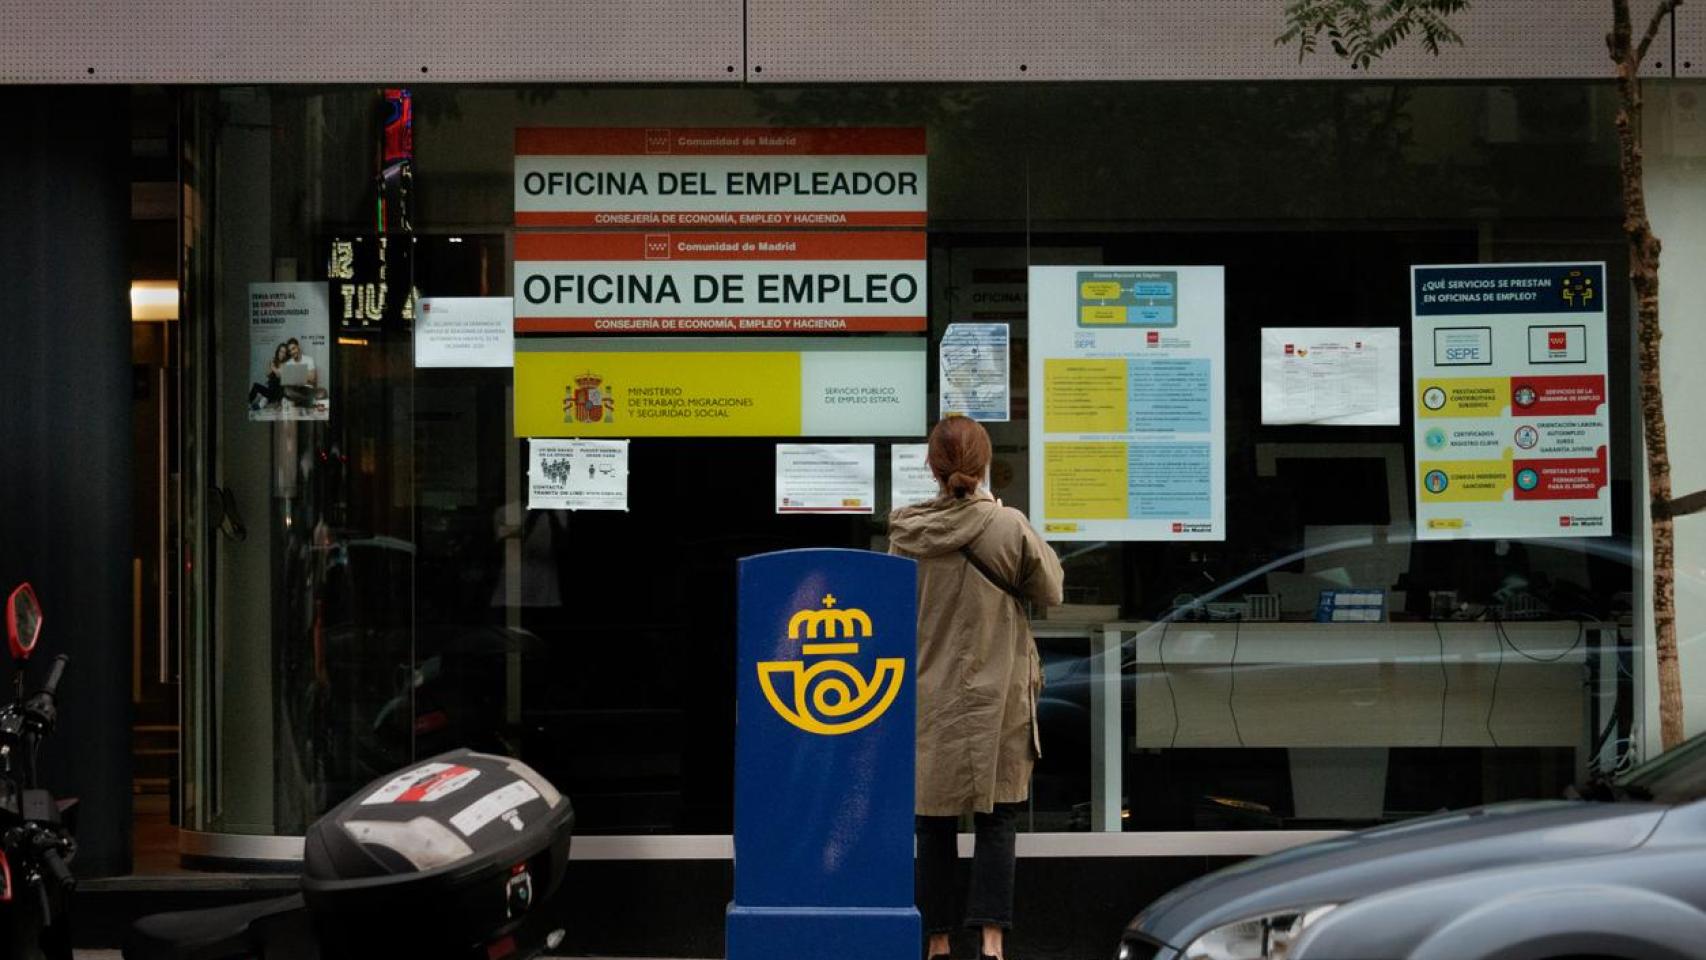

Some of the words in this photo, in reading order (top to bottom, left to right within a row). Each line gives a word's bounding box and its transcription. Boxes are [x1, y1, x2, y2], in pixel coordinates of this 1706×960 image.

[678, 137, 740, 147] Comunidad
[743, 137, 755, 147] de
[758, 137, 797, 147] Madrid
[523, 172, 648, 196] OFICINA
[658, 172, 716, 195] DEL
[727, 172, 918, 196] EMPLEADOR
[594, 212, 660, 225] CONSEJERÍA
[662, 212, 676, 225] DE
[677, 212, 737, 225] ECONOMÍA,
[740, 212, 782, 225] EMPLEO
[784, 212, 792, 225] Y
[794, 212, 847, 225] HACIENDA
[678, 241, 740, 252] Comunidad
[743, 241, 755, 252] de
[758, 241, 796, 252] Madrid
[523, 274, 681, 304] OFICINA
[694, 274, 745, 303] DE
[758, 274, 918, 304] EMPLEO
[1422, 278, 1446, 292] ¿QUÉ
[1450, 280, 1496, 289] SERVICIOS
[1498, 280, 1509, 288] SE
[1510, 279, 1551, 288] PRESTAN
[1424, 294, 1436, 303] EN
[1438, 294, 1481, 302] OFICINAS
[1483, 293, 1495, 301] DE
[1496, 292, 1537, 301] EMPLEO?
[594, 318, 660, 331] CONSEJERÍA
[662, 318, 676, 331] DE
[677, 318, 737, 331] ECONOMÍA,
[740, 318, 782, 331] EMPLEO
[784, 318, 792, 331] Y
[794, 318, 847, 331] HACIENDA
[1446, 348, 1480, 360] SEPE
[628, 388, 682, 397] MINISTERIO
[824, 387, 859, 396] SERVICIO
[860, 386, 896, 396] PÚBLICO
[628, 398, 642, 408] DE
[643, 398, 686, 409] TRABAJO,
[688, 398, 753, 408] MIGRACIONES
[824, 396, 835, 404] DE
[836, 396, 867, 404] EMPLEO
[868, 396, 900, 404] ESTATAL
[628, 409, 636, 418] Y
[637, 409, 692, 418] SEGURIDAD
[694, 409, 729, 418] SOCIAL
